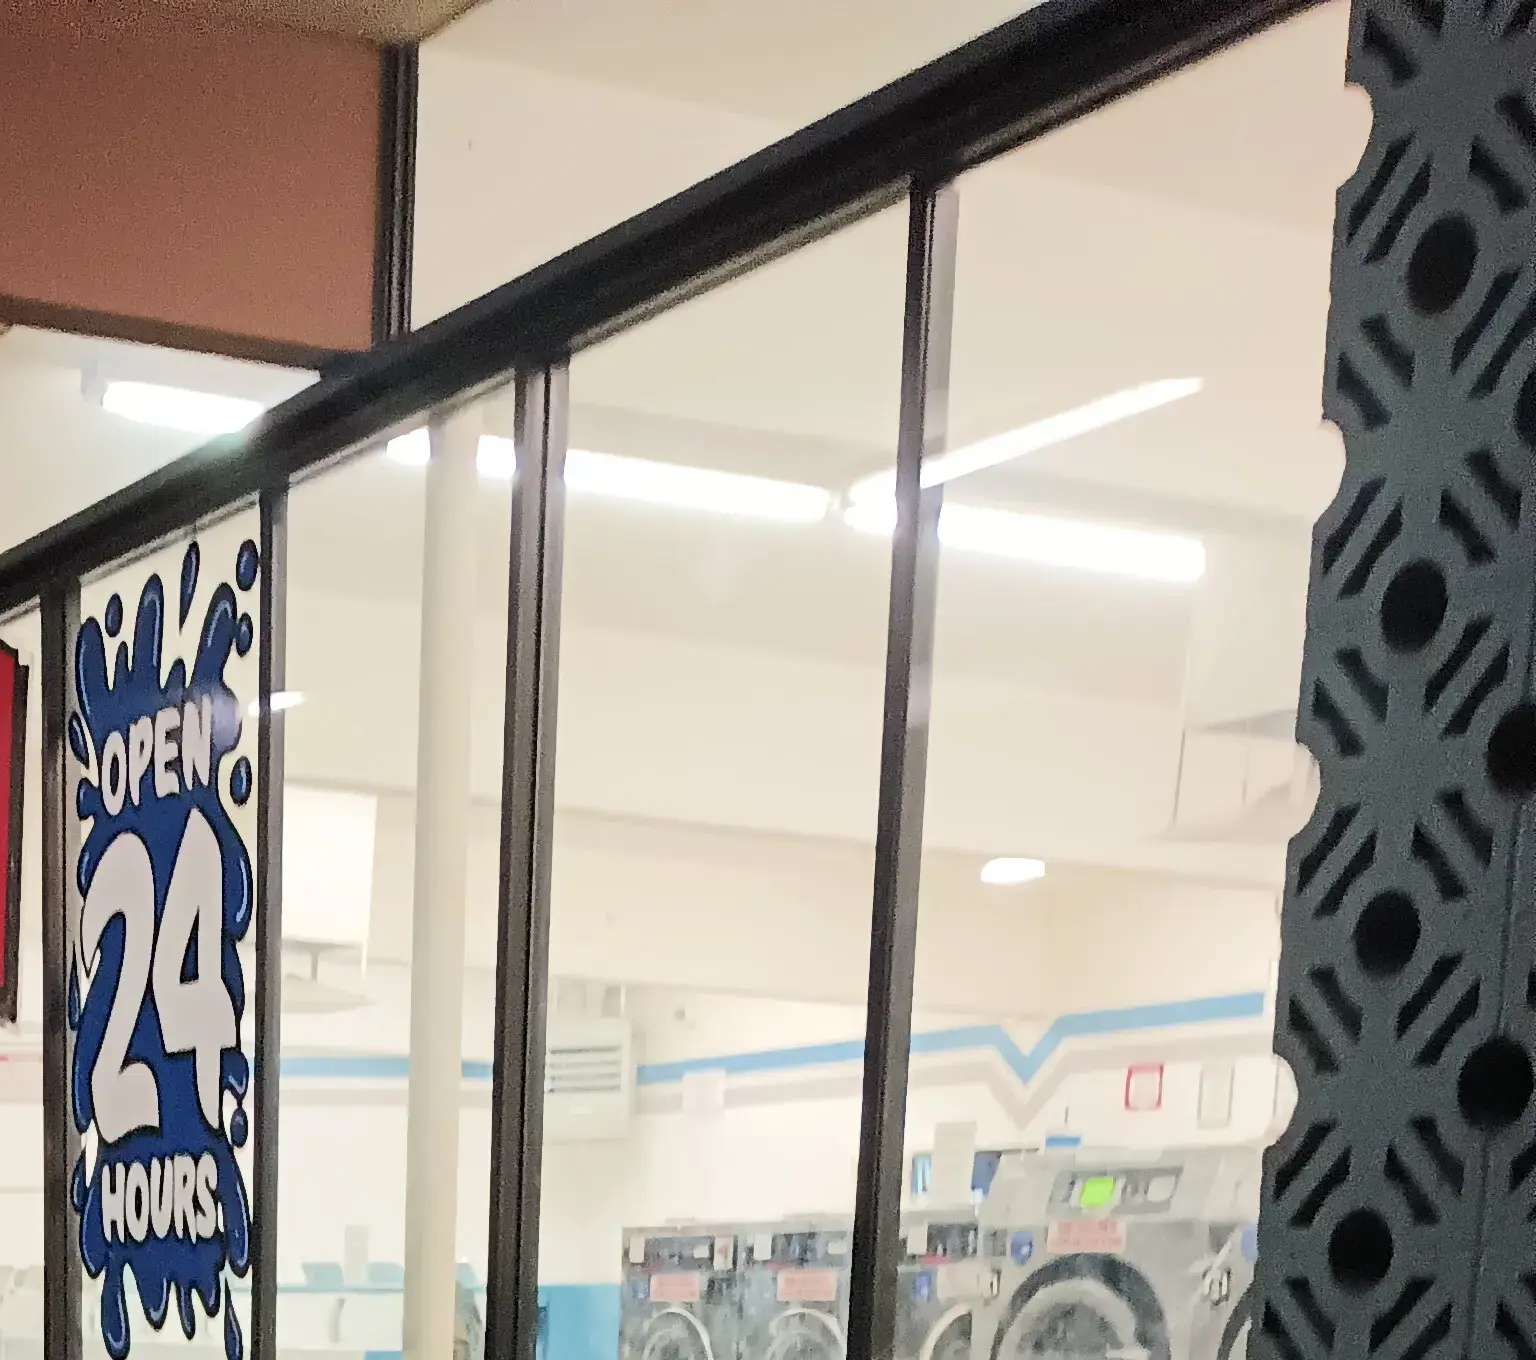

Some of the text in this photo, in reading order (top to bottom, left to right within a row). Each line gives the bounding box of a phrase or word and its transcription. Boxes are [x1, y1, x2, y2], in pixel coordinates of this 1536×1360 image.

[102, 693, 212, 816] OPEN
[80, 807, 237, 1144] 24
[101, 1152, 218, 1244] HOURS
